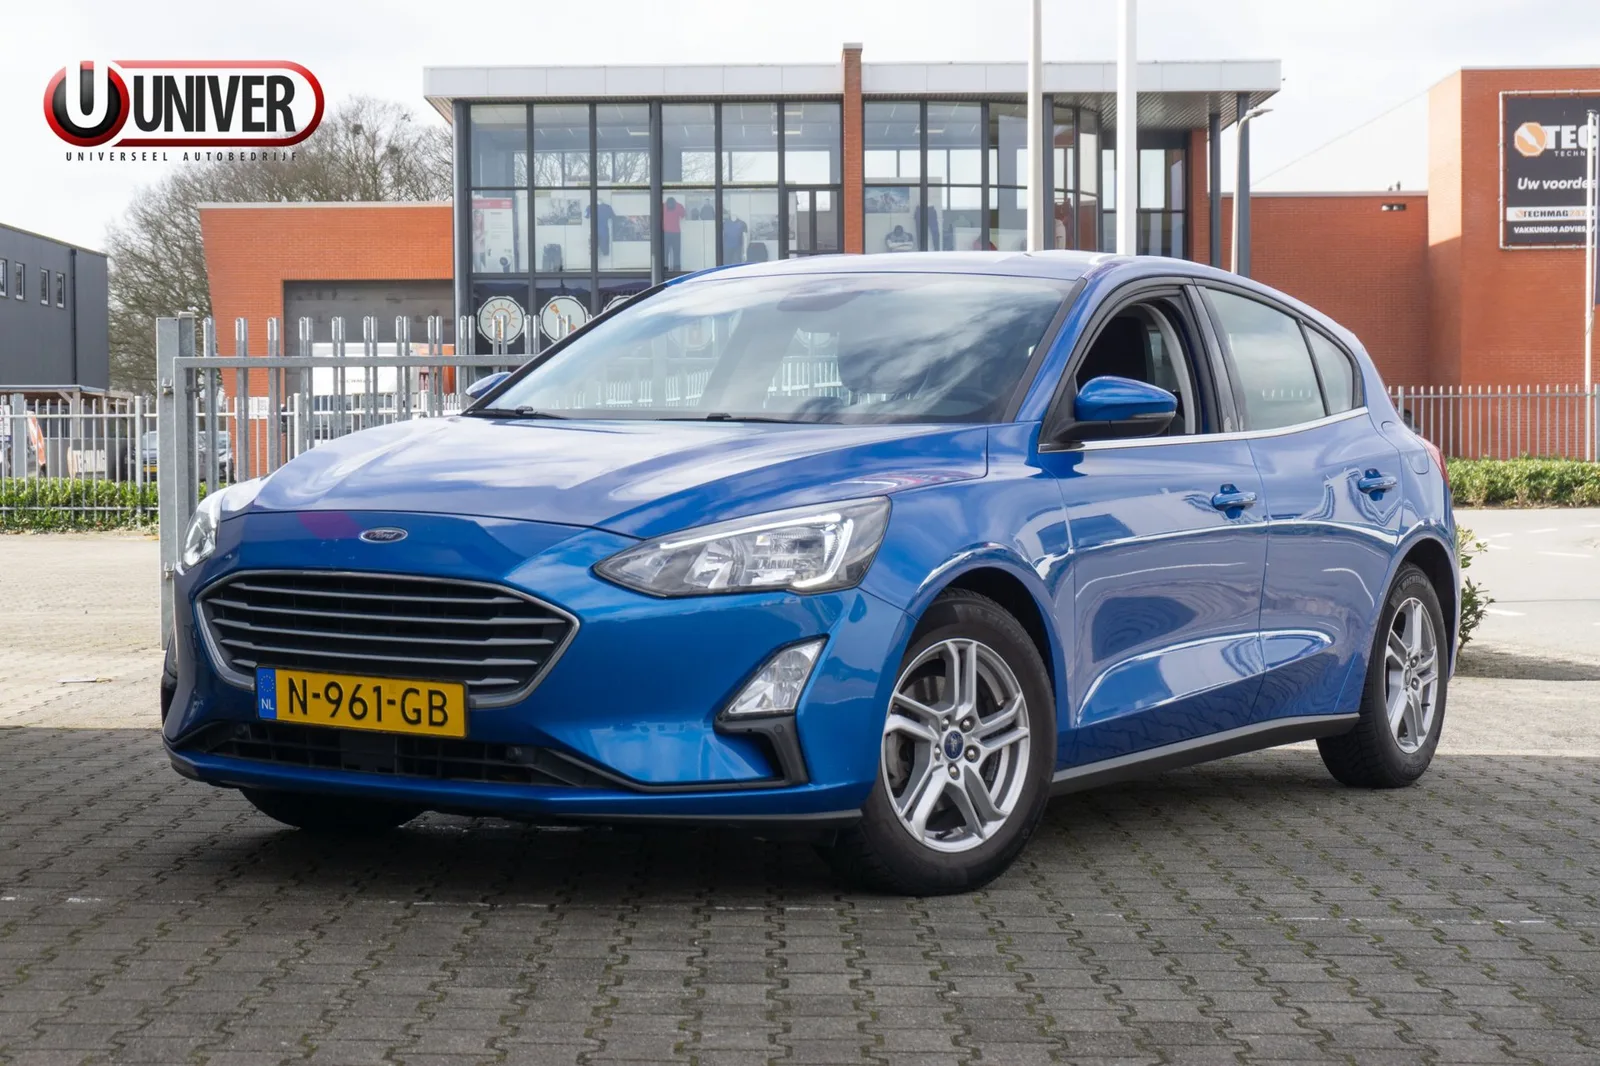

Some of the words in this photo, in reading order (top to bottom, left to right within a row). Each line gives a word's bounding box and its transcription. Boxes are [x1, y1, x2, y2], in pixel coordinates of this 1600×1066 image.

[1517, 177, 1540, 190] Uw
[1542, 176, 1596, 190] voorde
[1513, 225, 1559, 234] VAKKUNDIG
[260, 698, 275, 711] NL
[288, 677, 449, 728] N-961-GB
